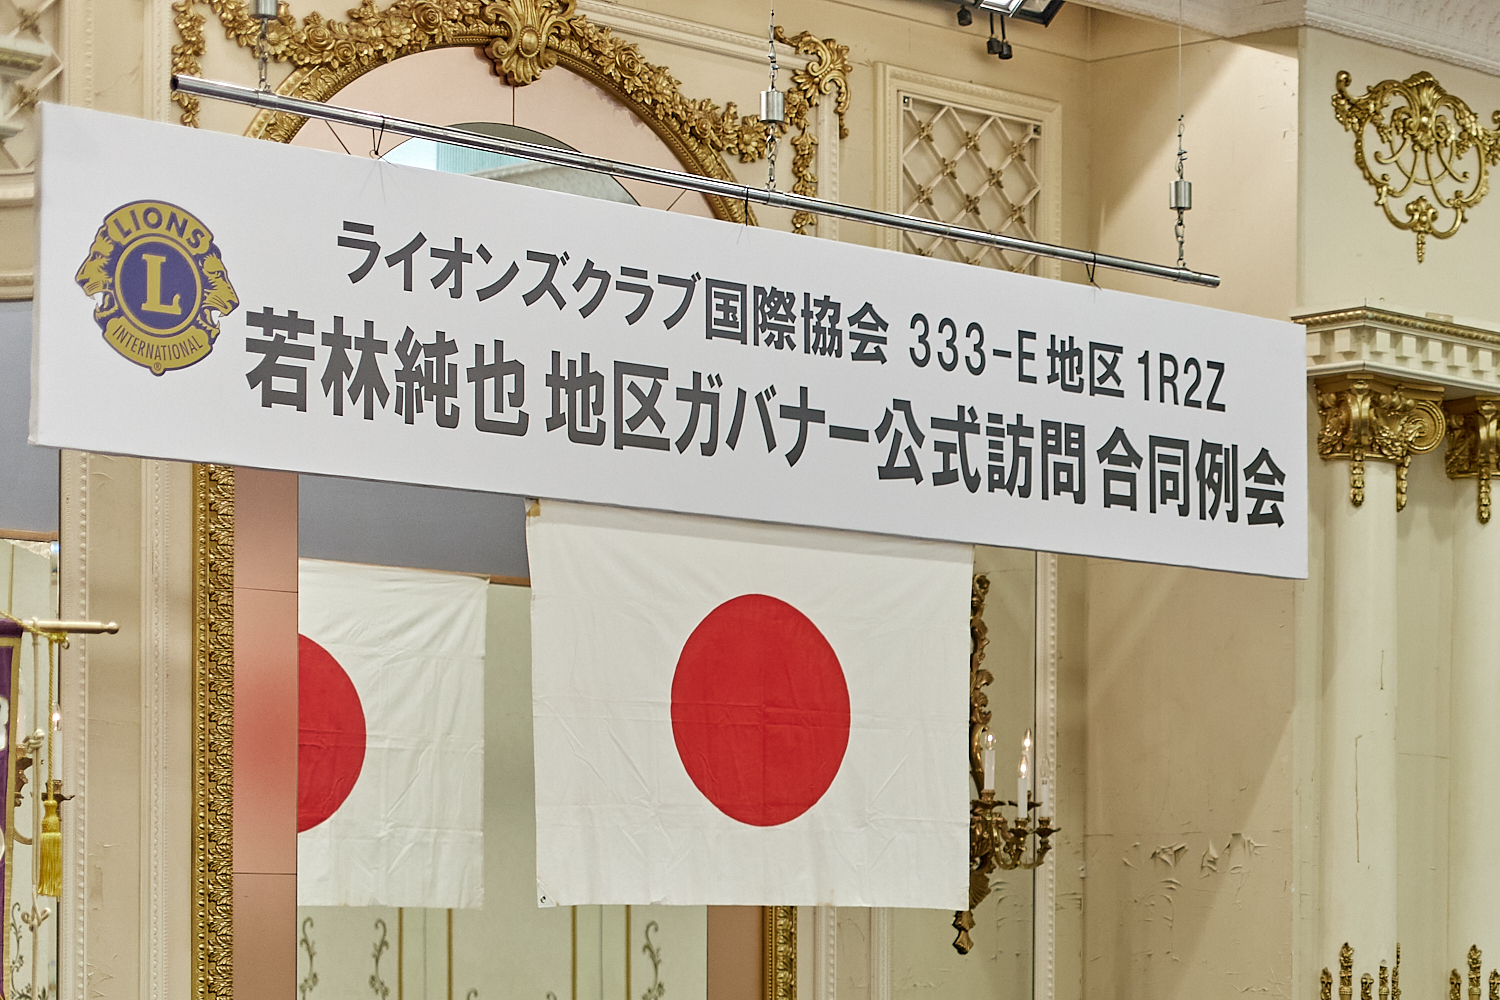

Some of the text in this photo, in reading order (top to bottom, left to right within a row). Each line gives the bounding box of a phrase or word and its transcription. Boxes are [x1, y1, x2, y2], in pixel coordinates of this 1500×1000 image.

[112, 206, 208, 251] LIONS
[140, 253, 183, 316] L
[111, 323, 204, 363] INTERNATIONAL
[337, 220, 889, 366] ライオンズクラブ国際協会
[1137, 349, 1227, 414] 1R2Z
[245, 306, 529, 437] 若林純也
